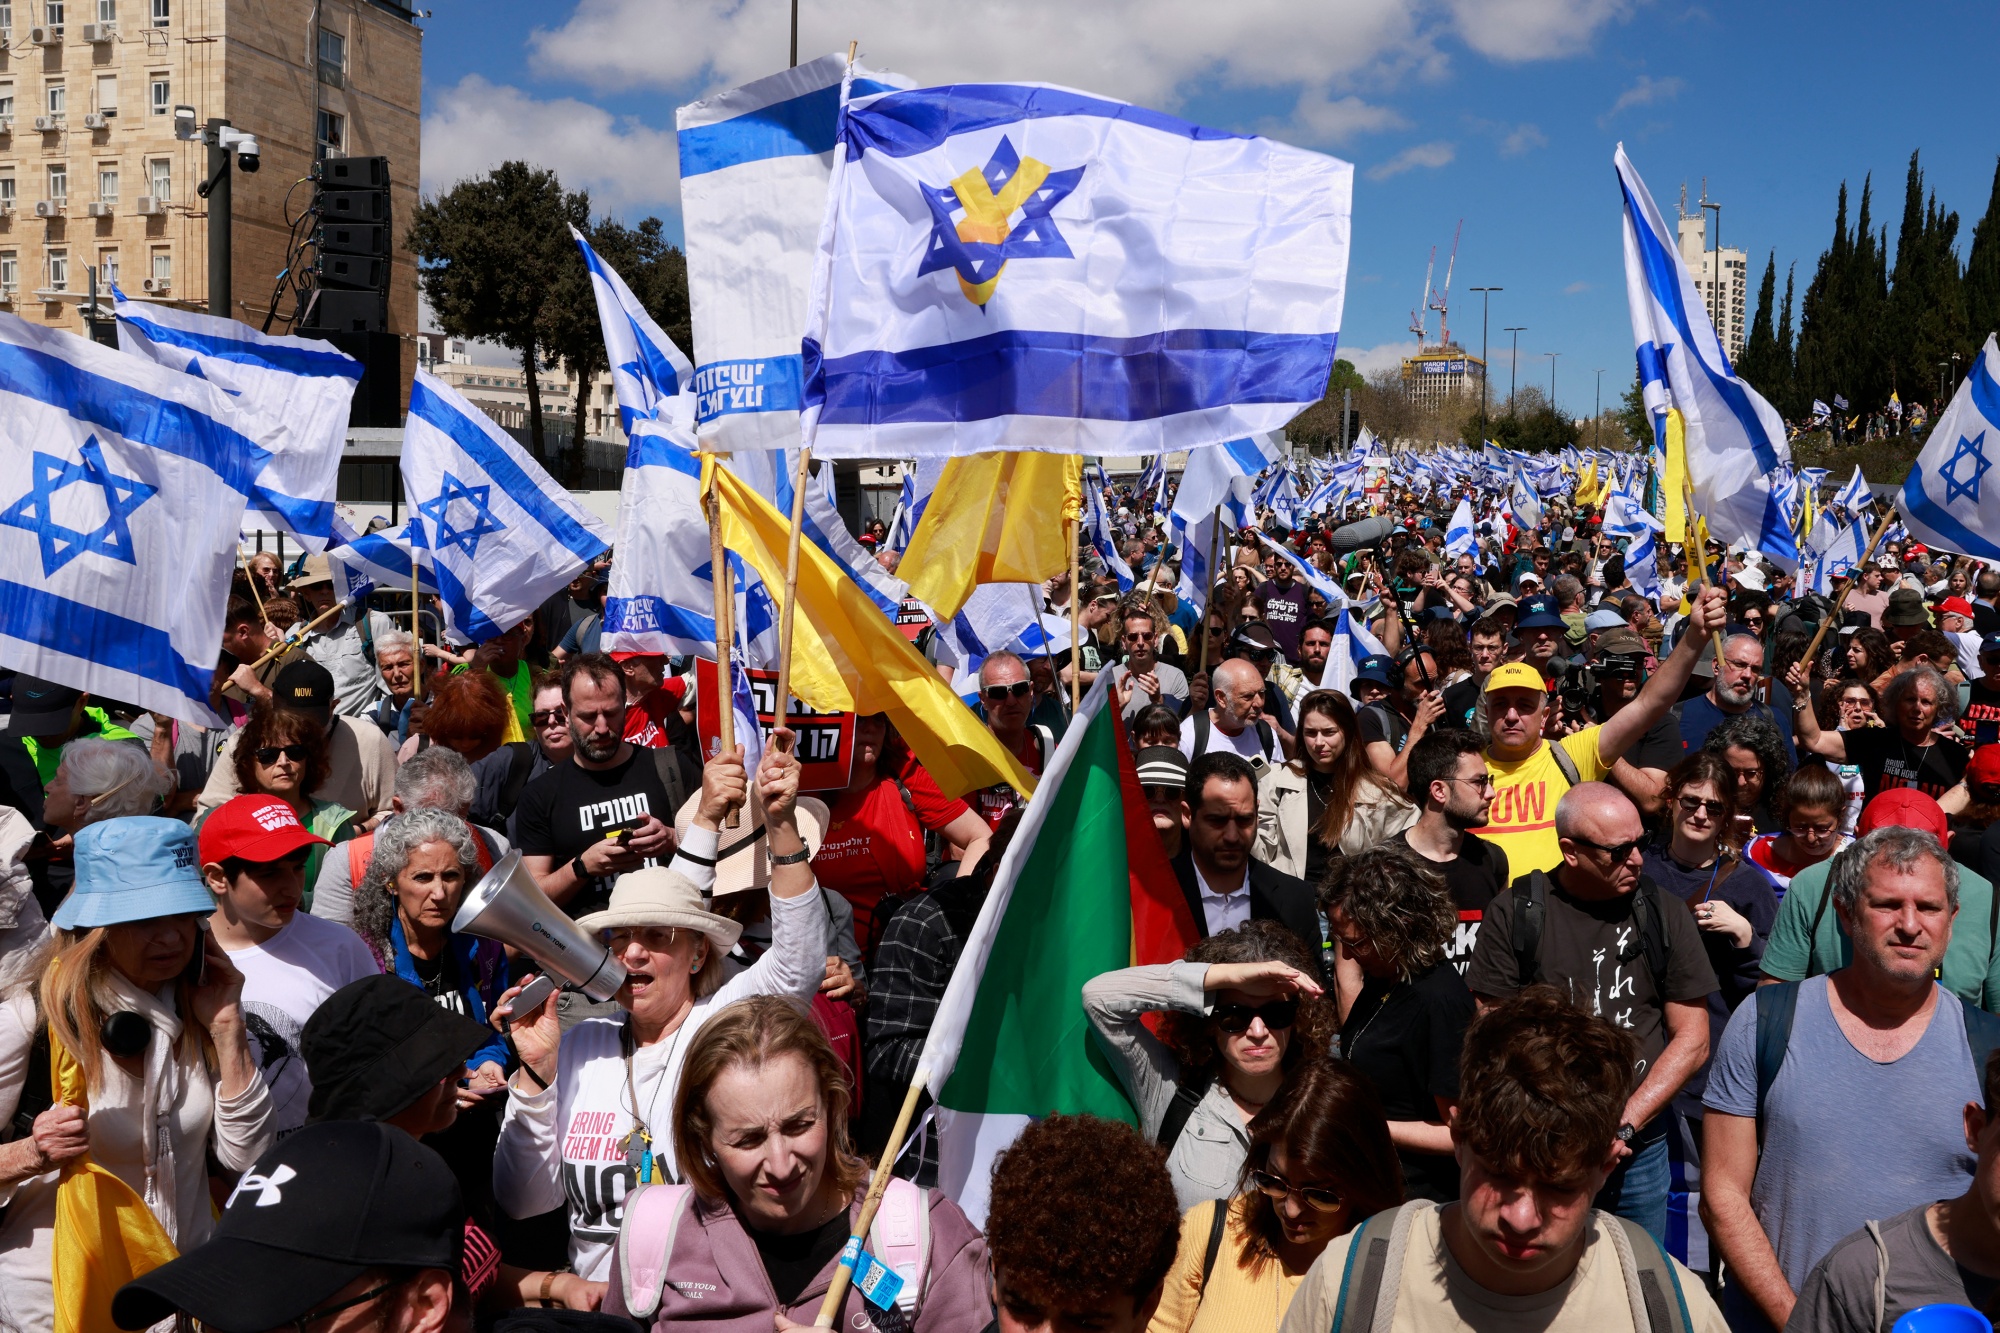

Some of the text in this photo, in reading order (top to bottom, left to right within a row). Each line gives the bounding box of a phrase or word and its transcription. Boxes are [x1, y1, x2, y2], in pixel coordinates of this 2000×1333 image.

[811, 728, 840, 759] קו
[1885, 758, 1905, 769] BRING
[1884, 765, 1918, 780] THEM HOME
[1492, 781, 1546, 823] OW
[251, 805, 273, 818] END
[579, 792, 651, 832] חטופים
[260, 815, 300, 832] WAR
[820, 837, 863, 851] אלטרנטיב
[569, 1111, 616, 1135] BRING
[564, 1135, 602, 1160] THEM
[694, 1282, 717, 1291] YOUR
